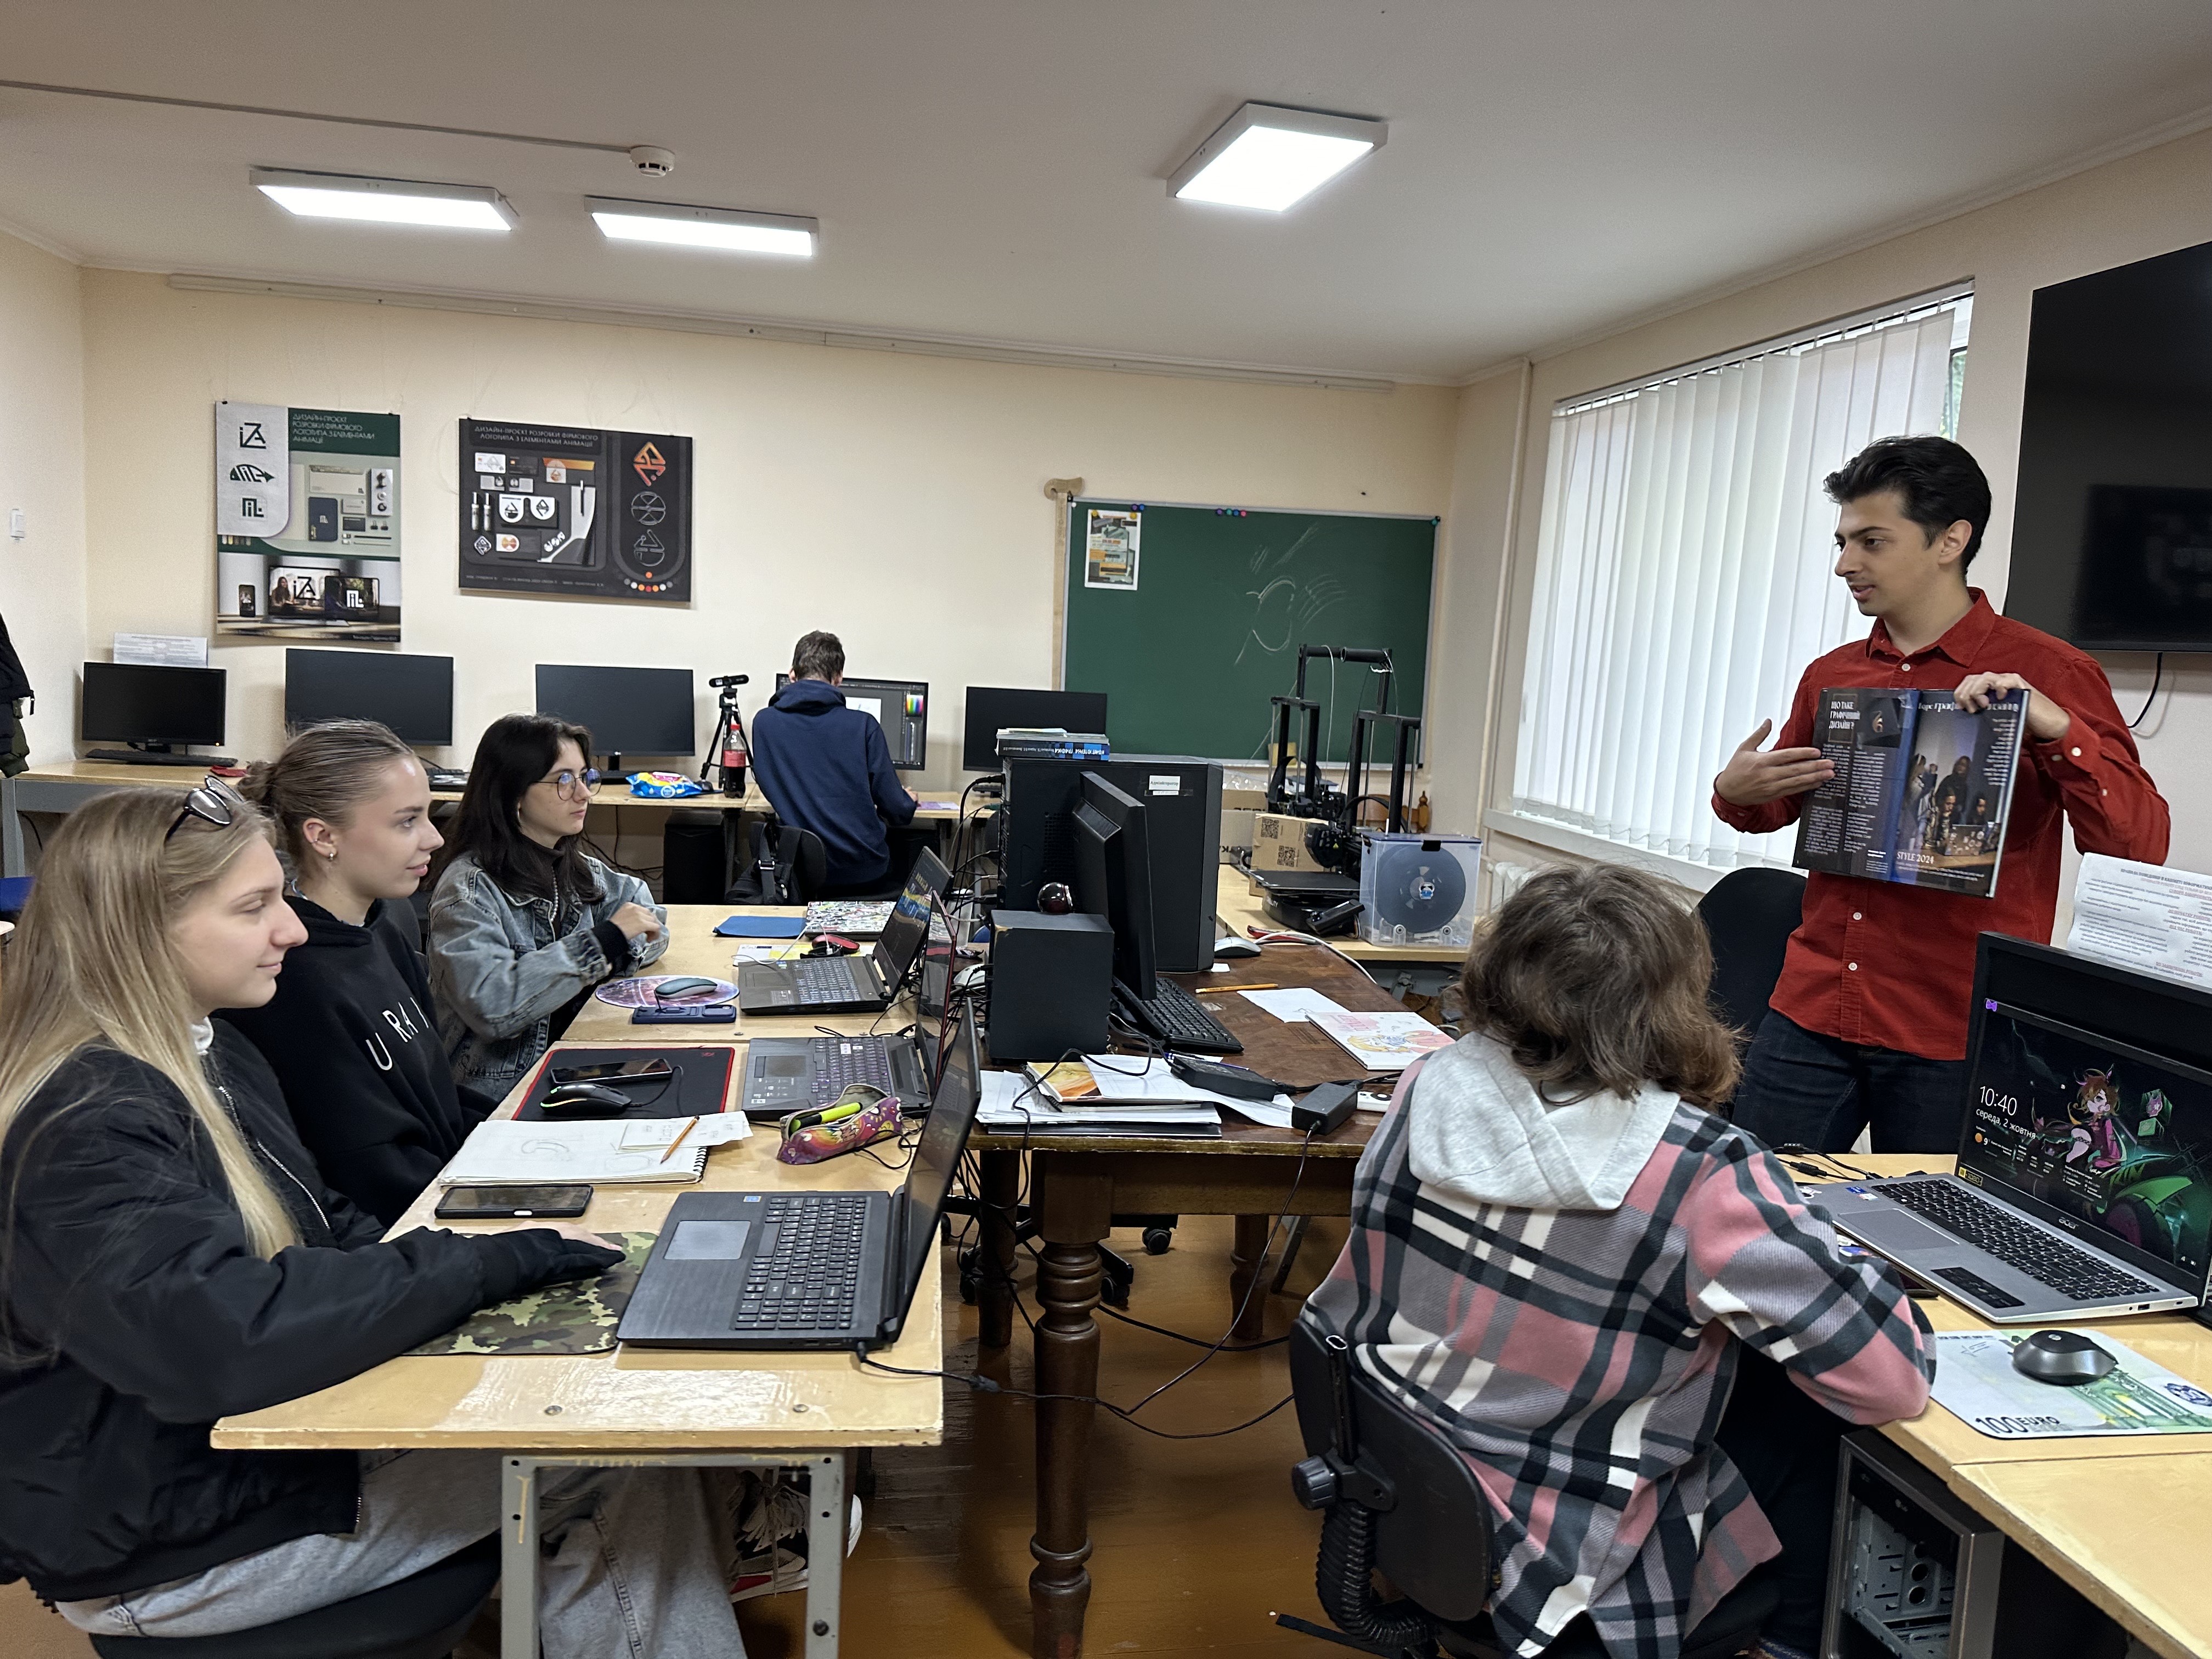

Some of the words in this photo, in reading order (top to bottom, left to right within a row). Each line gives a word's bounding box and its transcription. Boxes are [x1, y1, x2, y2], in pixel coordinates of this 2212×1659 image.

[1897, 851, 1917, 862] STYLE
[1916, 854, 1934, 864] 2024
[1980, 1086, 2017, 1116] 10:40
[1976, 1109, 2001, 1126] середа,
[2003, 1118, 2008, 1127] 2
[2009, 1122, 2036, 1139] жовтня
[2058, 1216, 2079, 1229] acer
[1975, 1416, 2028, 1434] 100
[2015, 1416, 2060, 1425] EURO
